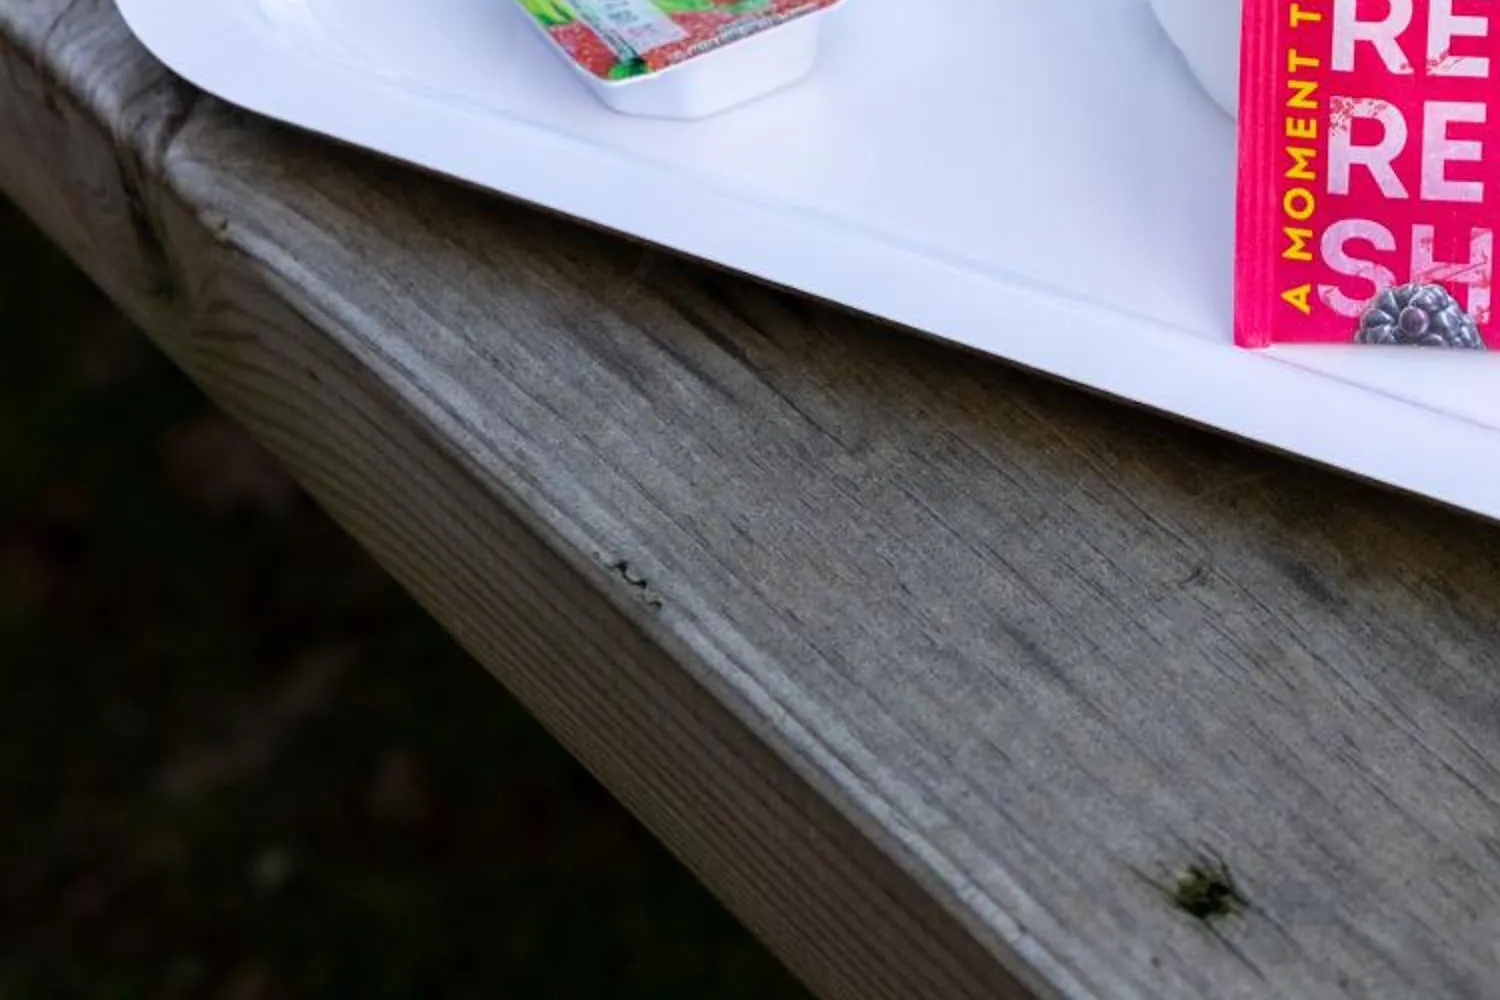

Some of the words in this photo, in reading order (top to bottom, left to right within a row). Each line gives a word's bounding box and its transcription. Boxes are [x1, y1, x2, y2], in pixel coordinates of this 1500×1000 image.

[1282, 48, 1320, 262] MOMENT
[1326, 96, 1488, 203] RE
[1281, 284, 1312, 316] A
[1317, 218, 1494, 325] SH
